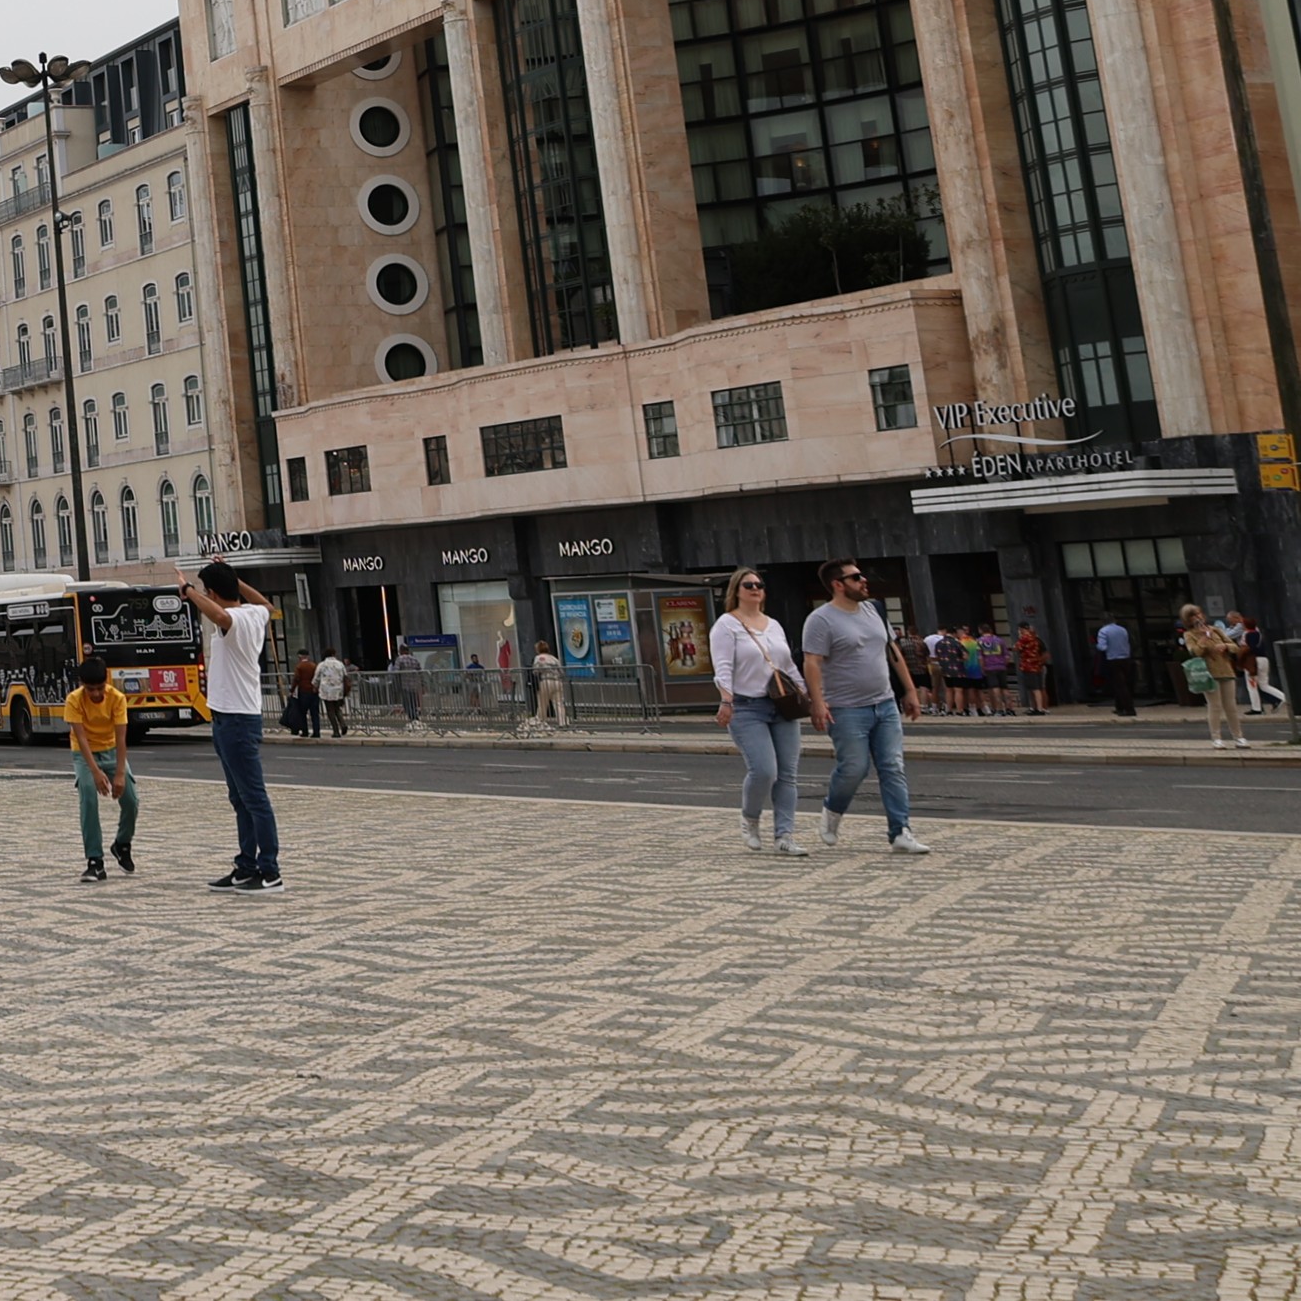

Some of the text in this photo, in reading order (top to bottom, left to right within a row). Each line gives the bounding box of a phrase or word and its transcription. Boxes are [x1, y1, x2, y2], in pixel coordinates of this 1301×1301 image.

[933, 393, 1076, 430] VIP Executive
[971, 450, 1134, 478] ÉDEN APARTHOTEL
[198, 530, 252, 555] MANGO
[558, 538, 613, 557] MANGO
[342, 556, 383, 572] MANGO
[442, 548, 489, 566] MANGO
